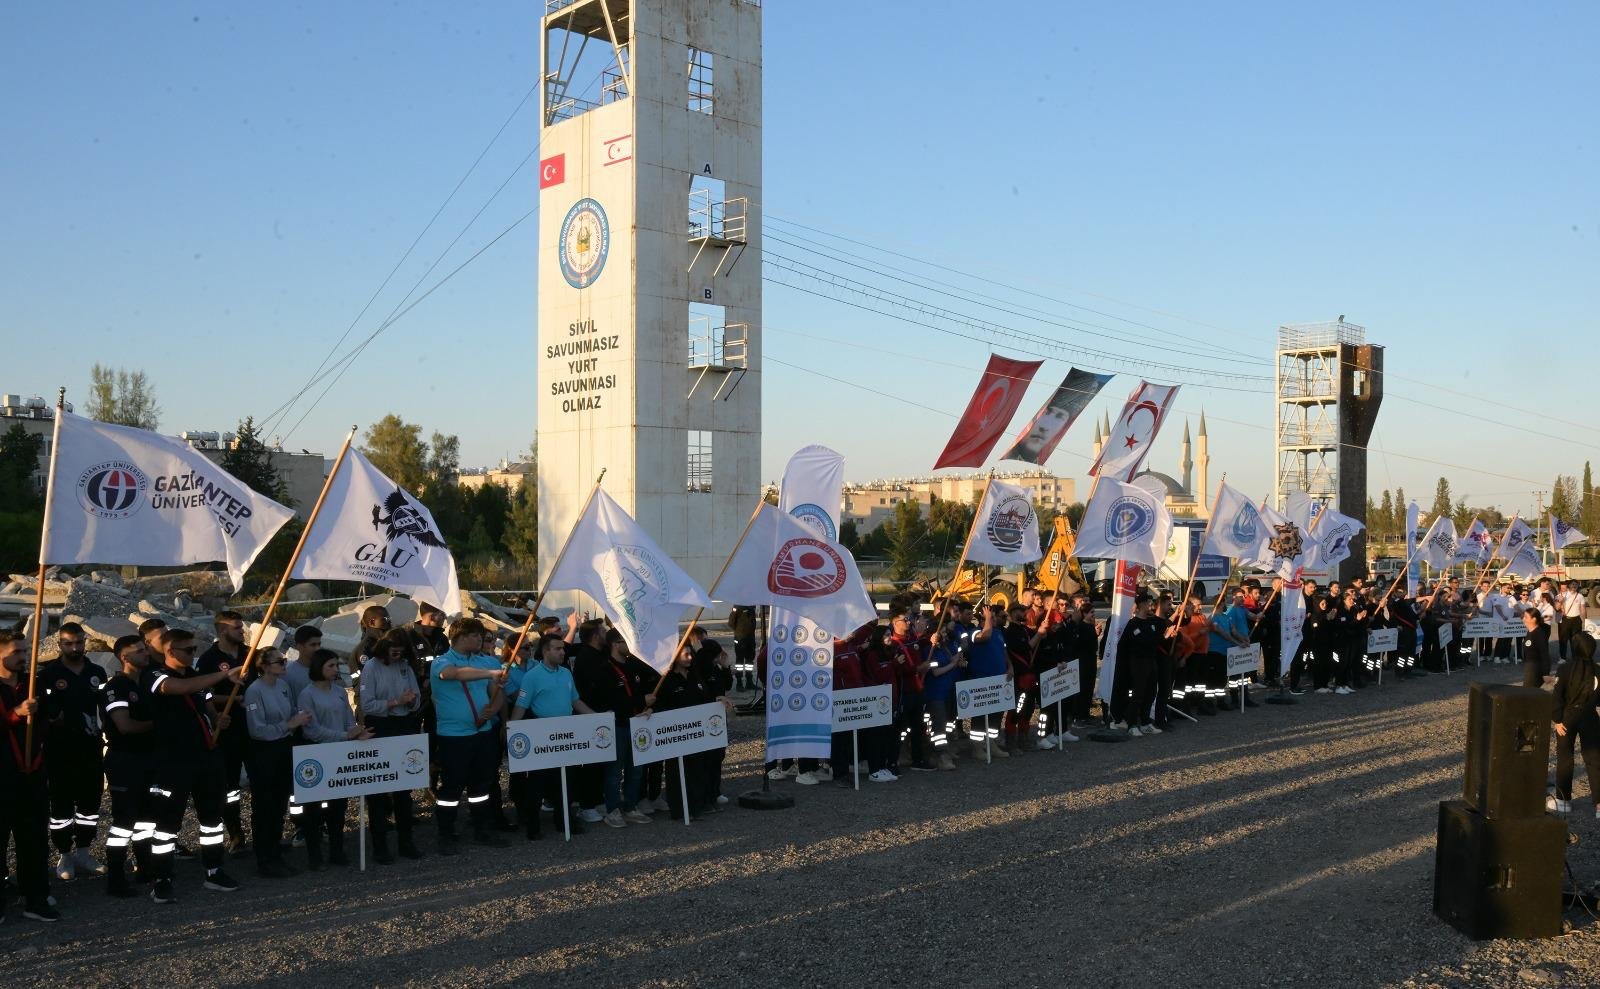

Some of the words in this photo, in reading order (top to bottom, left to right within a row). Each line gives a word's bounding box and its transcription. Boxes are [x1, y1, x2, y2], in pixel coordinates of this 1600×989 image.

[703, 164, 712, 174] A
[704, 288, 712, 300] B
[569, 318, 598, 336] SİVİL
[547, 335, 620, 358] SAVUNMASIZ
[568, 358, 598, 375] YURT
[551, 374, 616, 396] SAVUNMASI
[562, 396, 602, 414] OLMAZ
[154, 469, 252, 520] GAZİANTEP
[151, 494, 242, 539] ÜNİVERESİ
[354, 543, 415, 568] GAU
[1050, 552, 1058, 576] JCB
[656, 720, 702, 735] GÜMÜŞHANE
[549, 732, 574, 741] GİRNE
[655, 730, 705, 747] ÜNİVERSİTESİ
[348, 750, 379, 760] GİRNE
[534, 740, 590, 755] ÜNİVERSİTESİ
[336, 761, 390, 774] AMERİKAN
[328, 771, 398, 788] ÜNİVERSİTESİ
